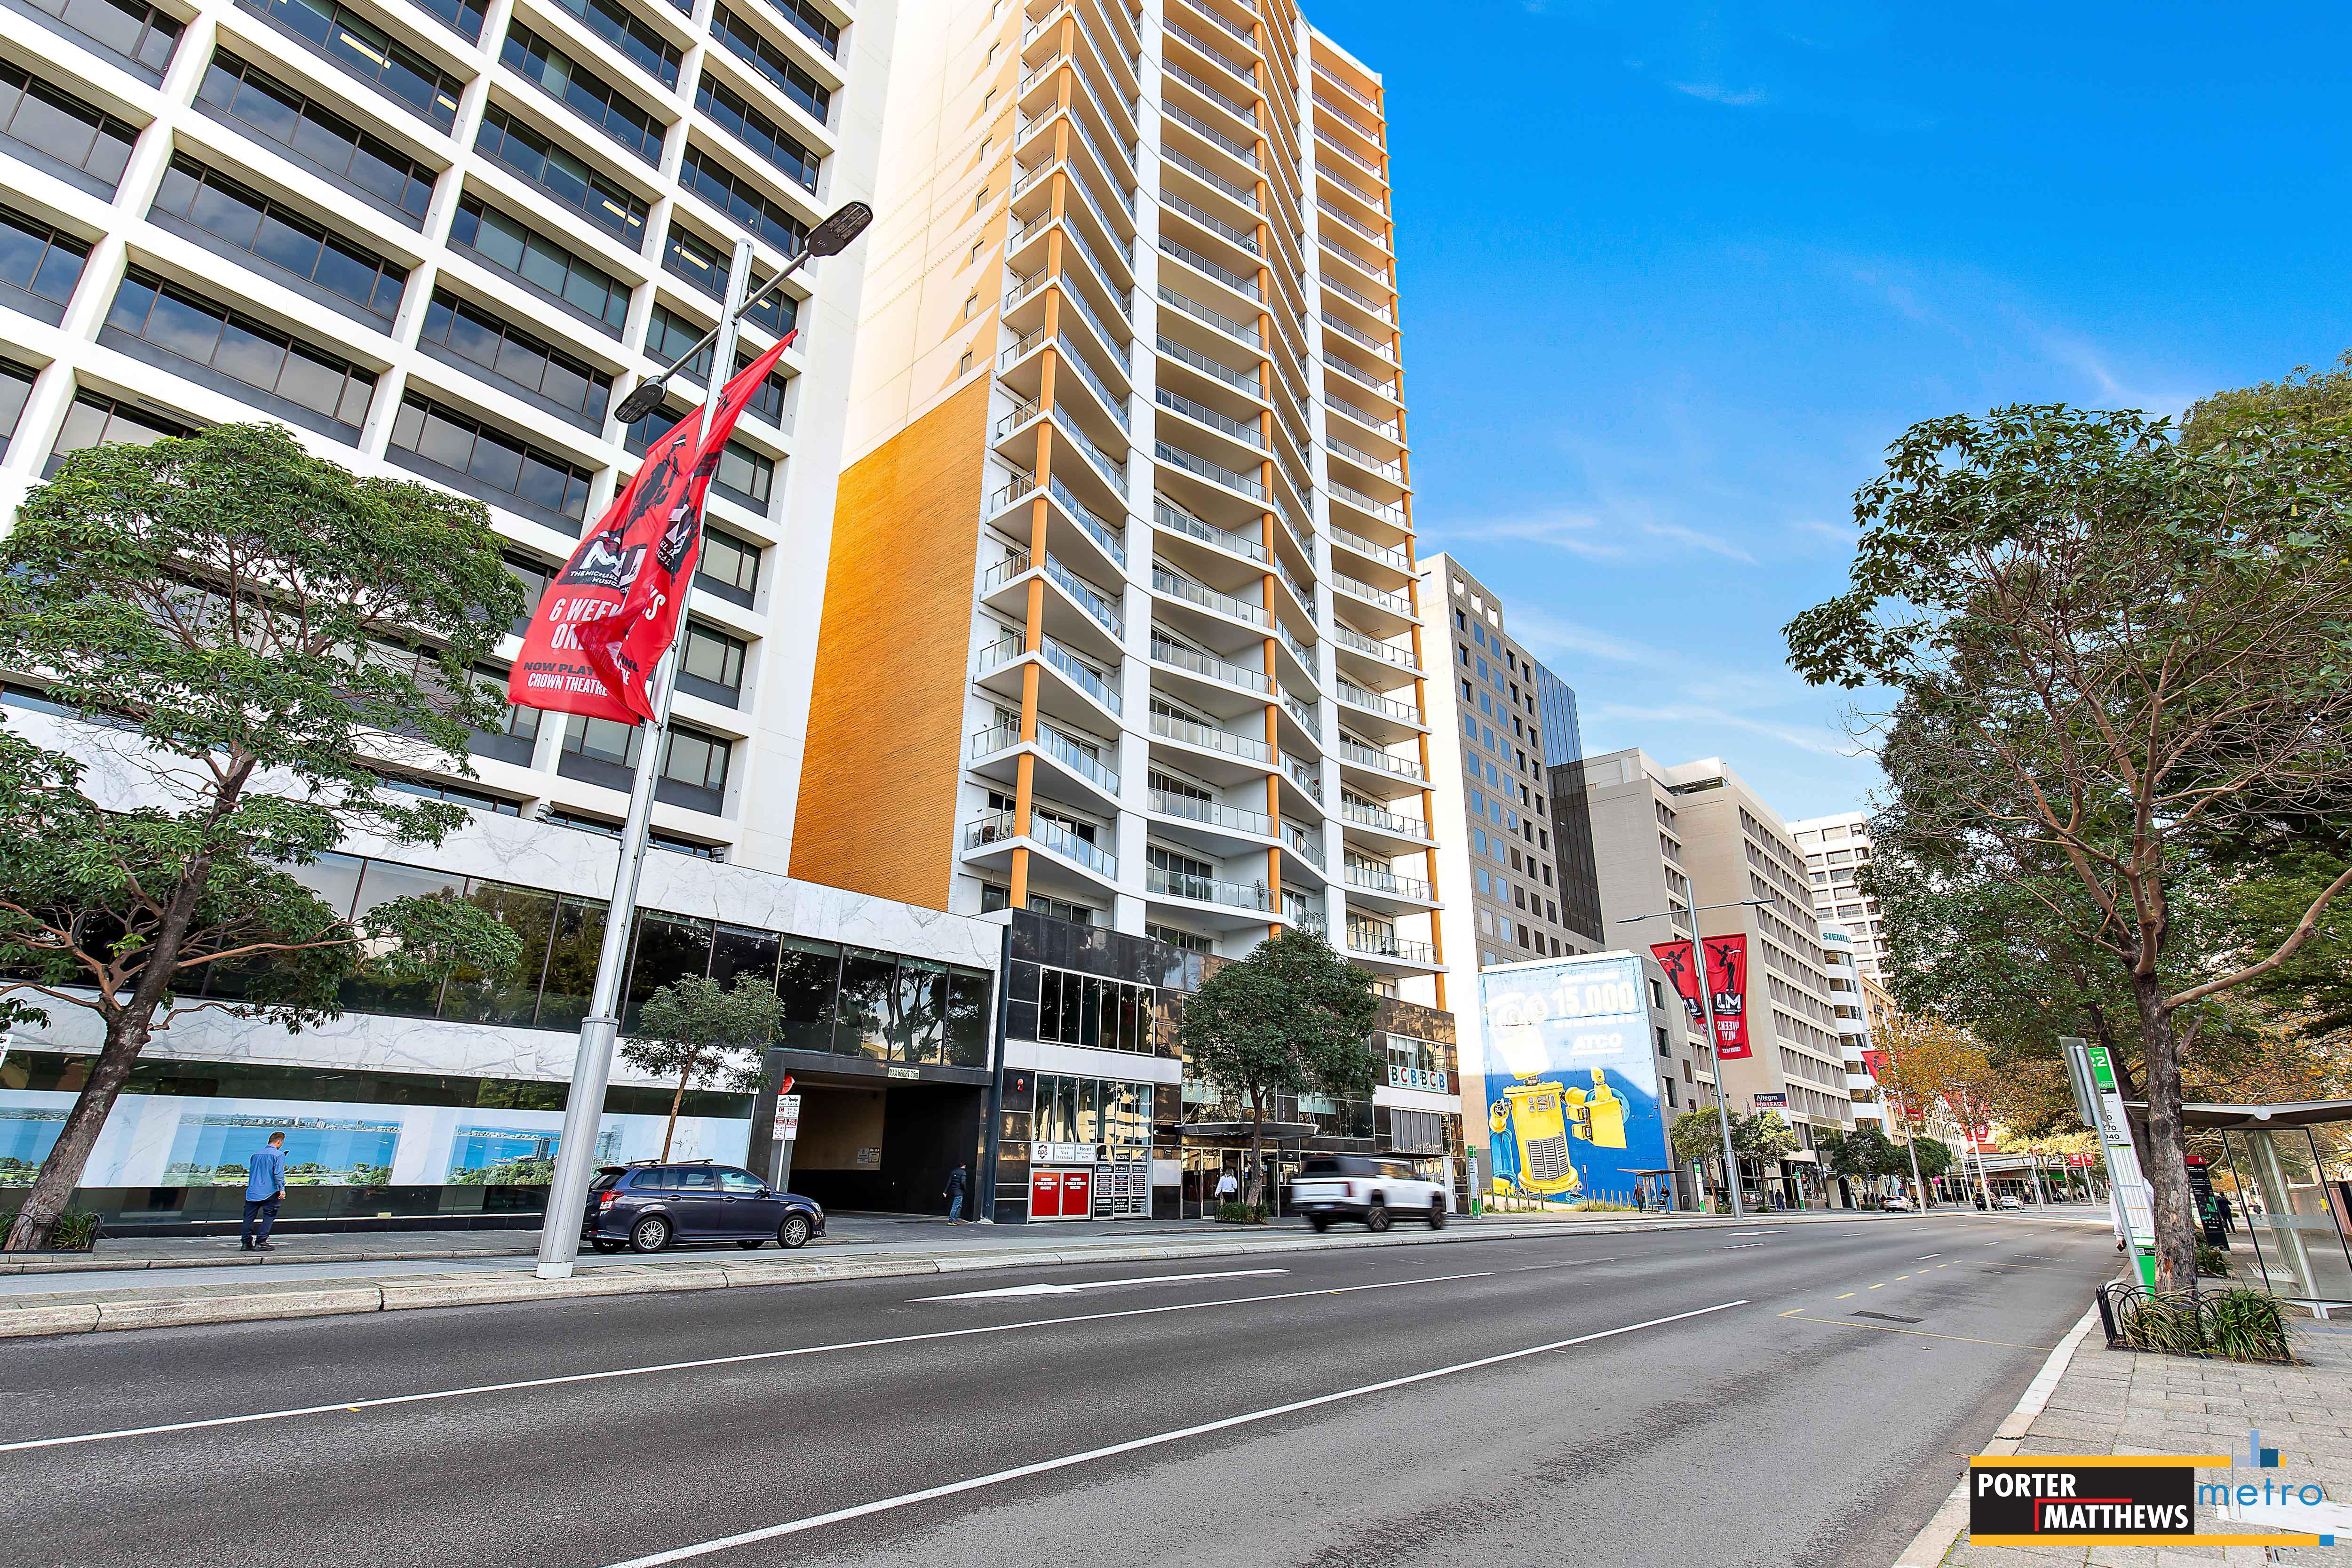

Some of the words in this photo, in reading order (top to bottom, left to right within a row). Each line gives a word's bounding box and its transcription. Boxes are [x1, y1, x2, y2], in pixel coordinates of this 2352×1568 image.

[549, 598, 566, 621] 6
[524, 662, 556, 671] NOW
[558, 663, 595, 676] PLAY
[527, 673, 565, 689] CROWN
[564, 676, 608, 696] THEATRE
[1573, 1033, 1622, 1049] ATCO
[889, 1068, 898, 1077] MAX
